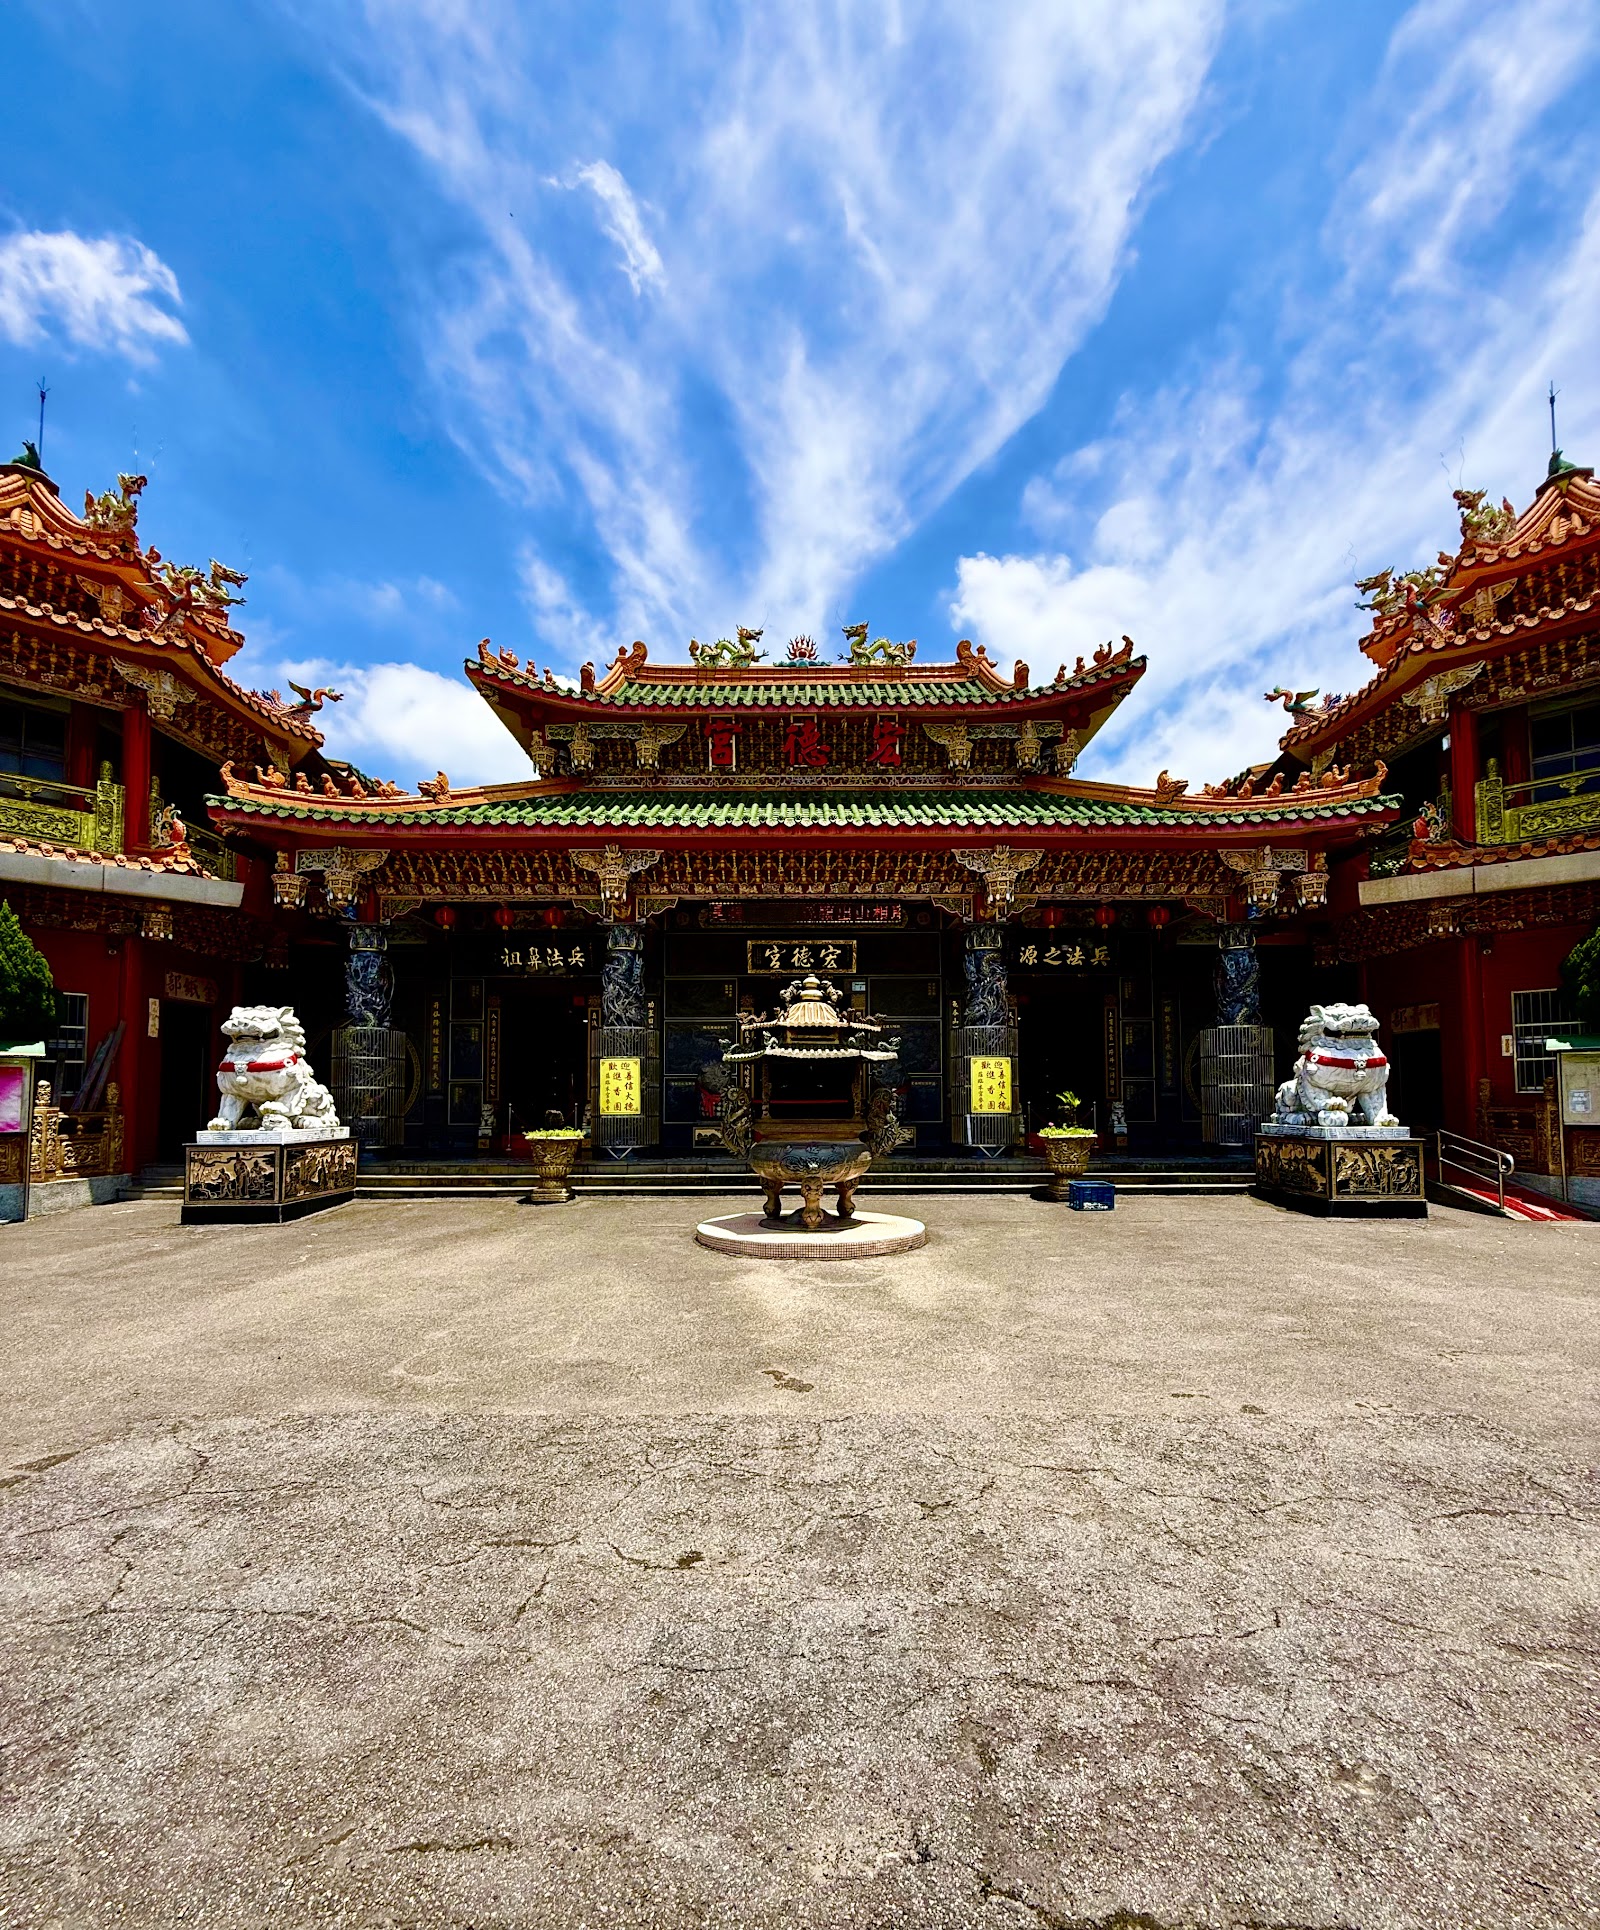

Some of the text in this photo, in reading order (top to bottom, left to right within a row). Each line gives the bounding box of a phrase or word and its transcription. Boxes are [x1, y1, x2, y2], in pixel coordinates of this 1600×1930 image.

[500, 945, 586, 970] 兵法鼻祖
[764, 945, 842, 969] 宏德宮
[1019, 944, 1111, 967] 兵法之源
[608, 1062, 631, 1071] 歡迎
[981, 1061, 1003, 1069] 歡迎
[625, 1071, 634, 1111] 善信大德
[998, 1070, 1007, 1110] 善信大德
